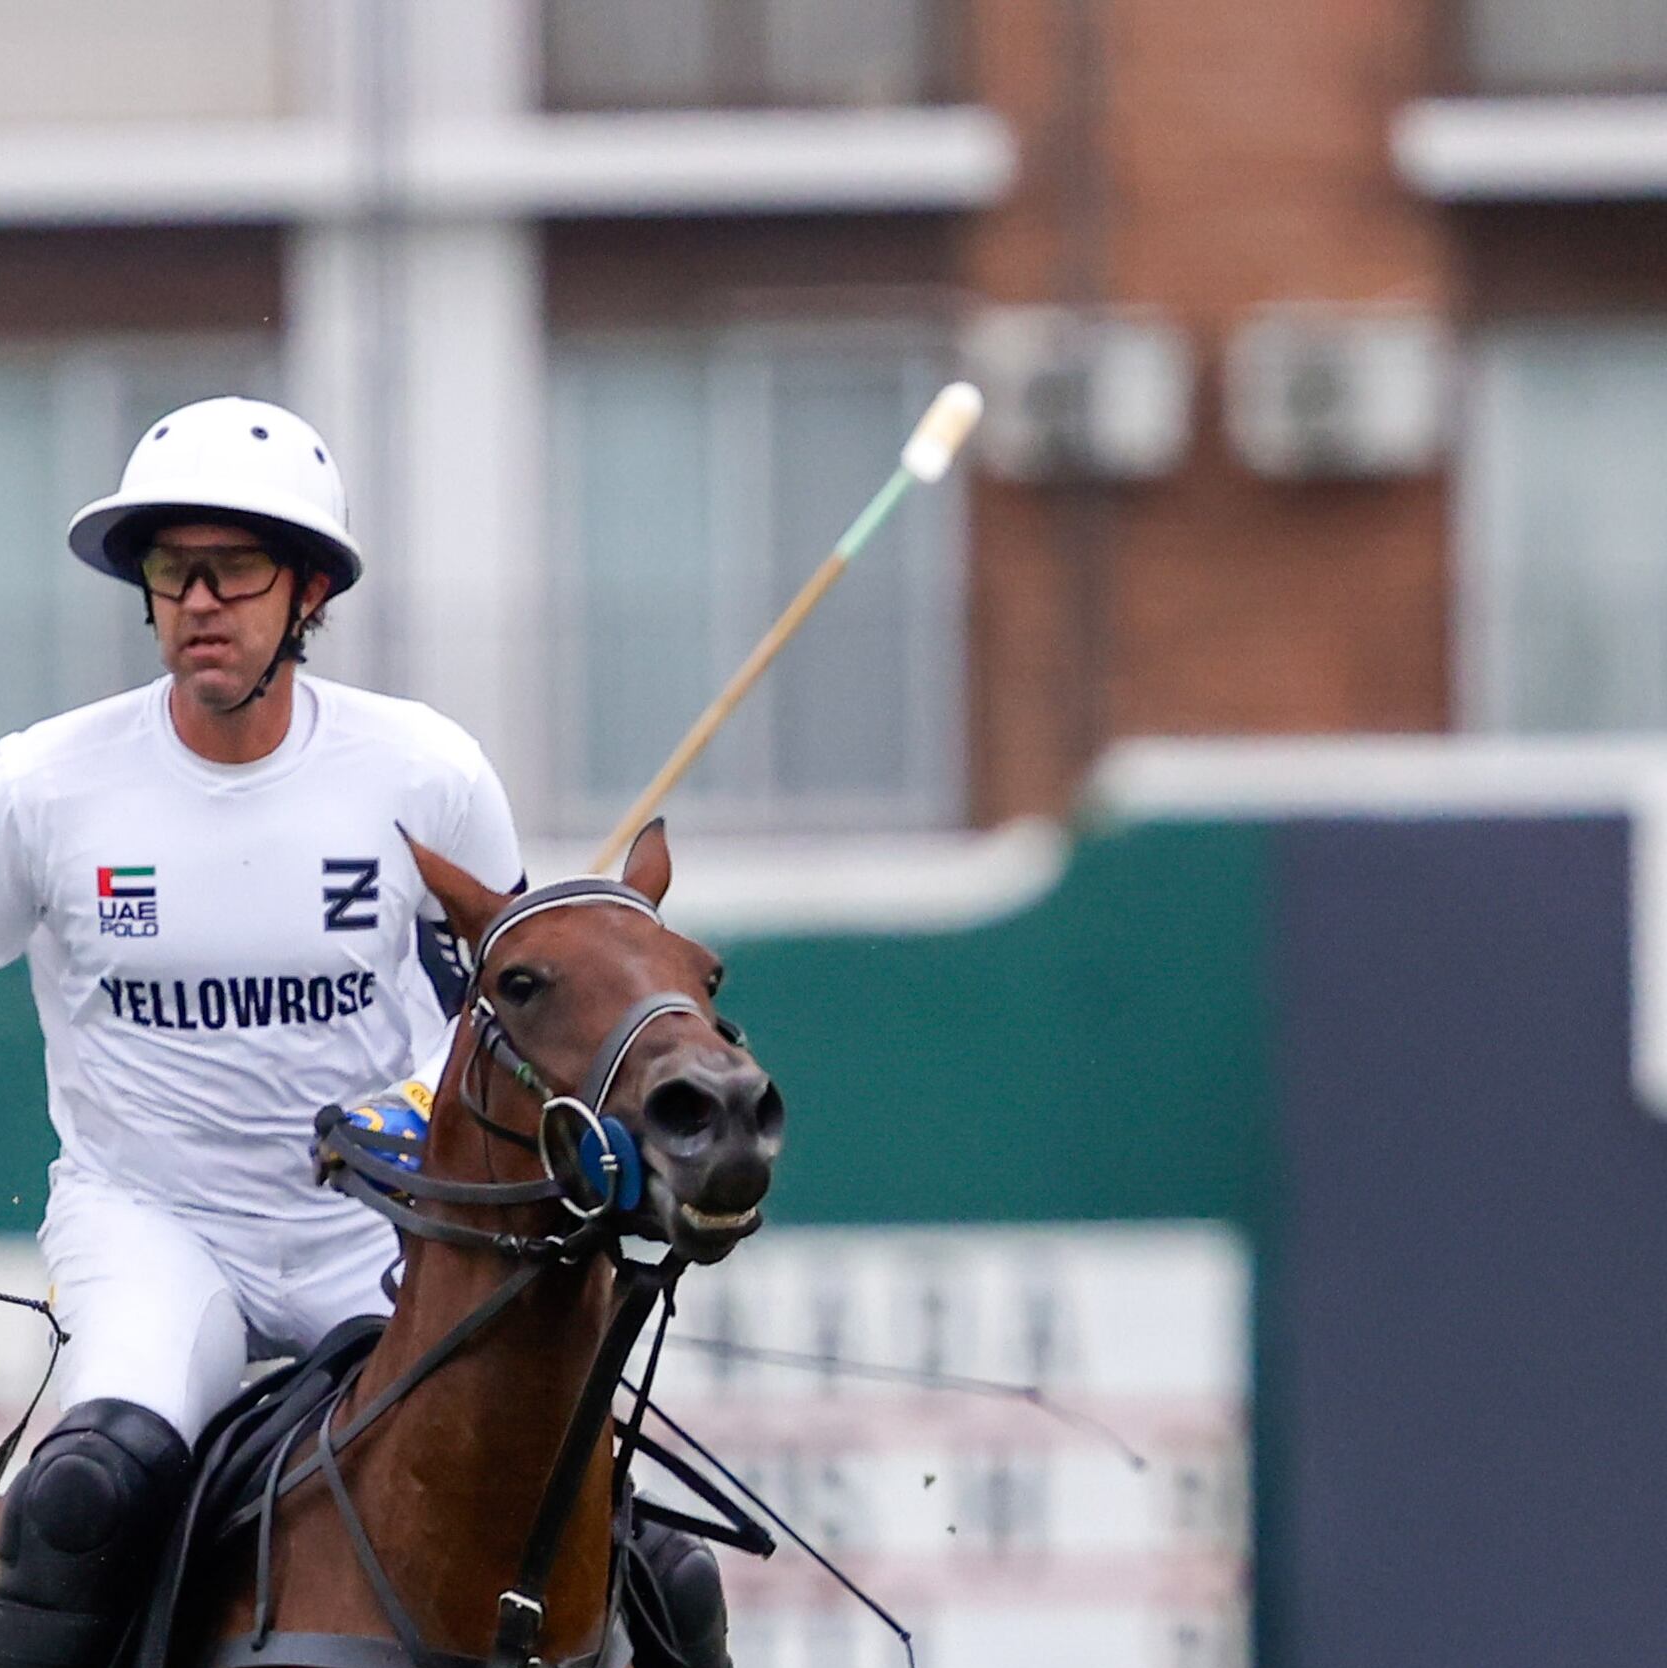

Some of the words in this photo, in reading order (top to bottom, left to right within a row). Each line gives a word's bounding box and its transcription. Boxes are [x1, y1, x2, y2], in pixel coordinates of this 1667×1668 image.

[98, 901, 157, 921] UAE
[100, 921, 159, 938] POLO
[99, 971, 377, 1031] YELLOWROSE
